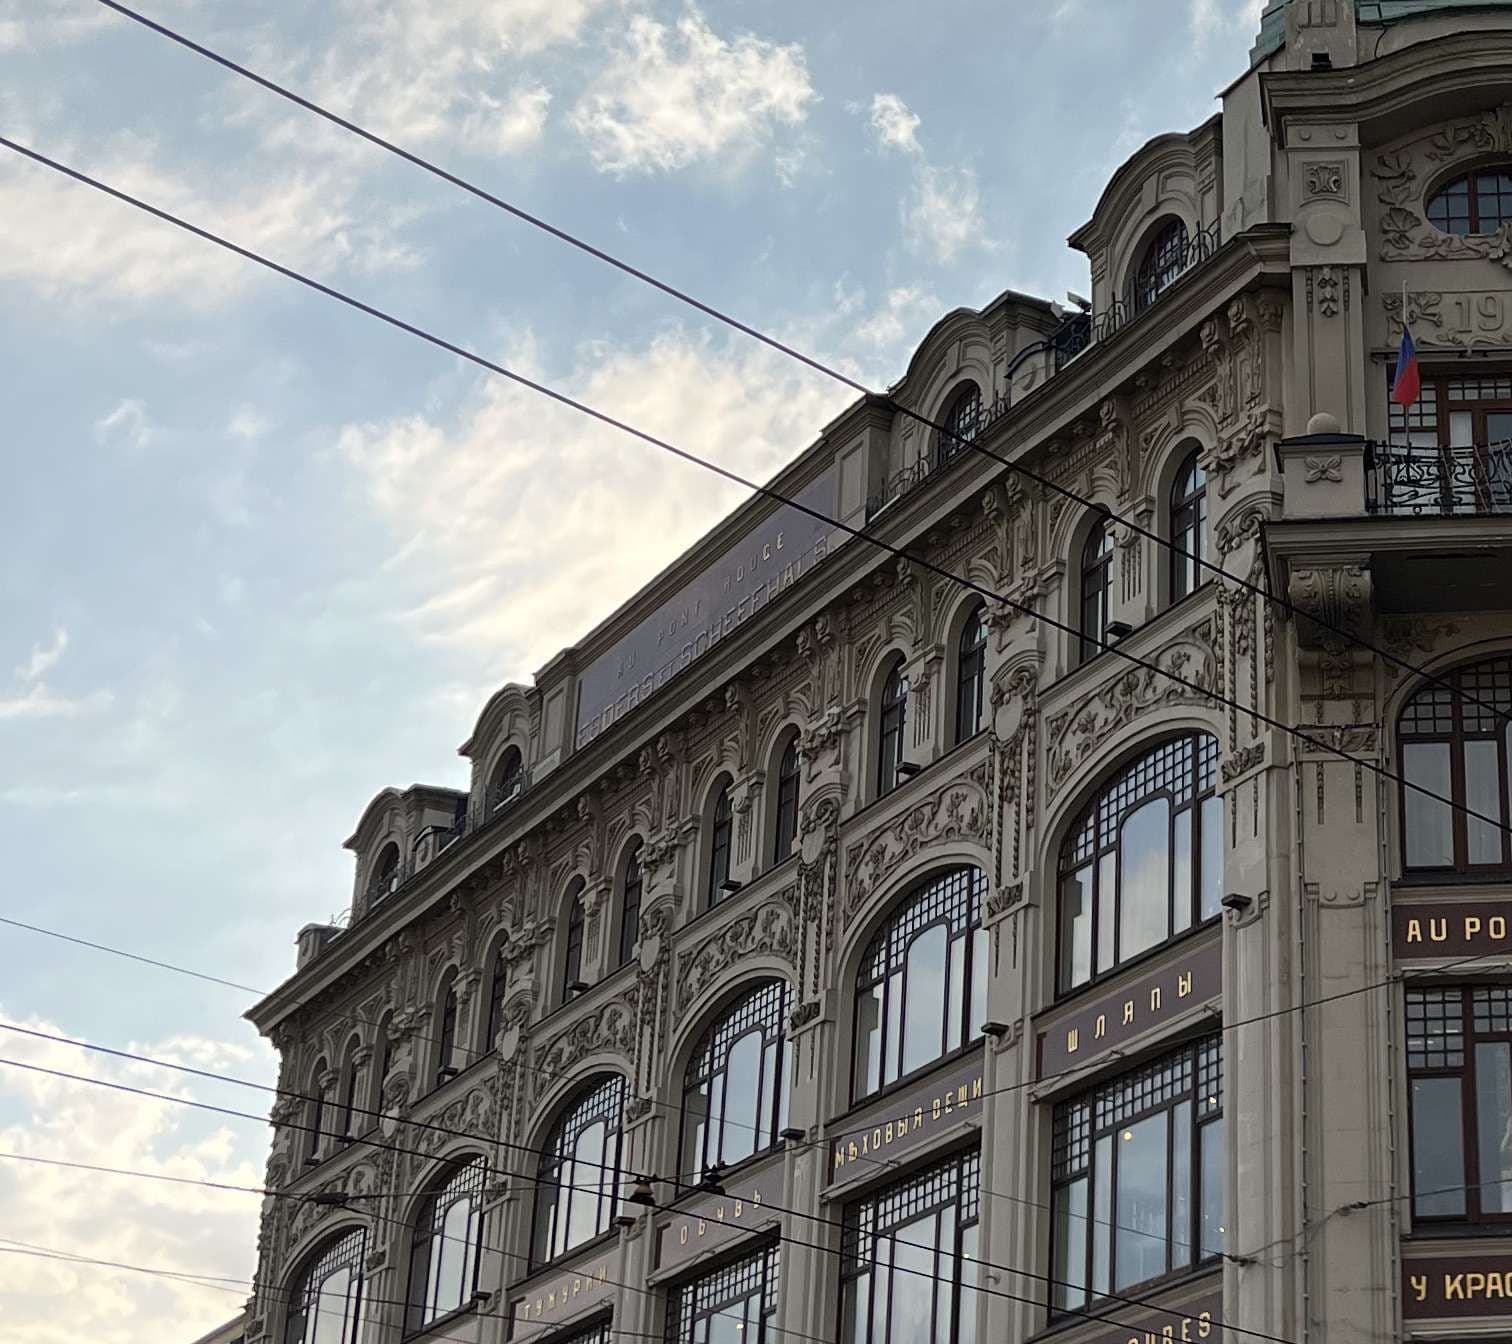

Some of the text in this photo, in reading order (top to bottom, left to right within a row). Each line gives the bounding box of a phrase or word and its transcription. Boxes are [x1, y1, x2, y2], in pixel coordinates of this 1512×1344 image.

[1406, 917, 1448, 943] AU
[1066, 970, 1193, 1054] ШЛЯПЫ
[1410, 1274, 1427, 1302] У
